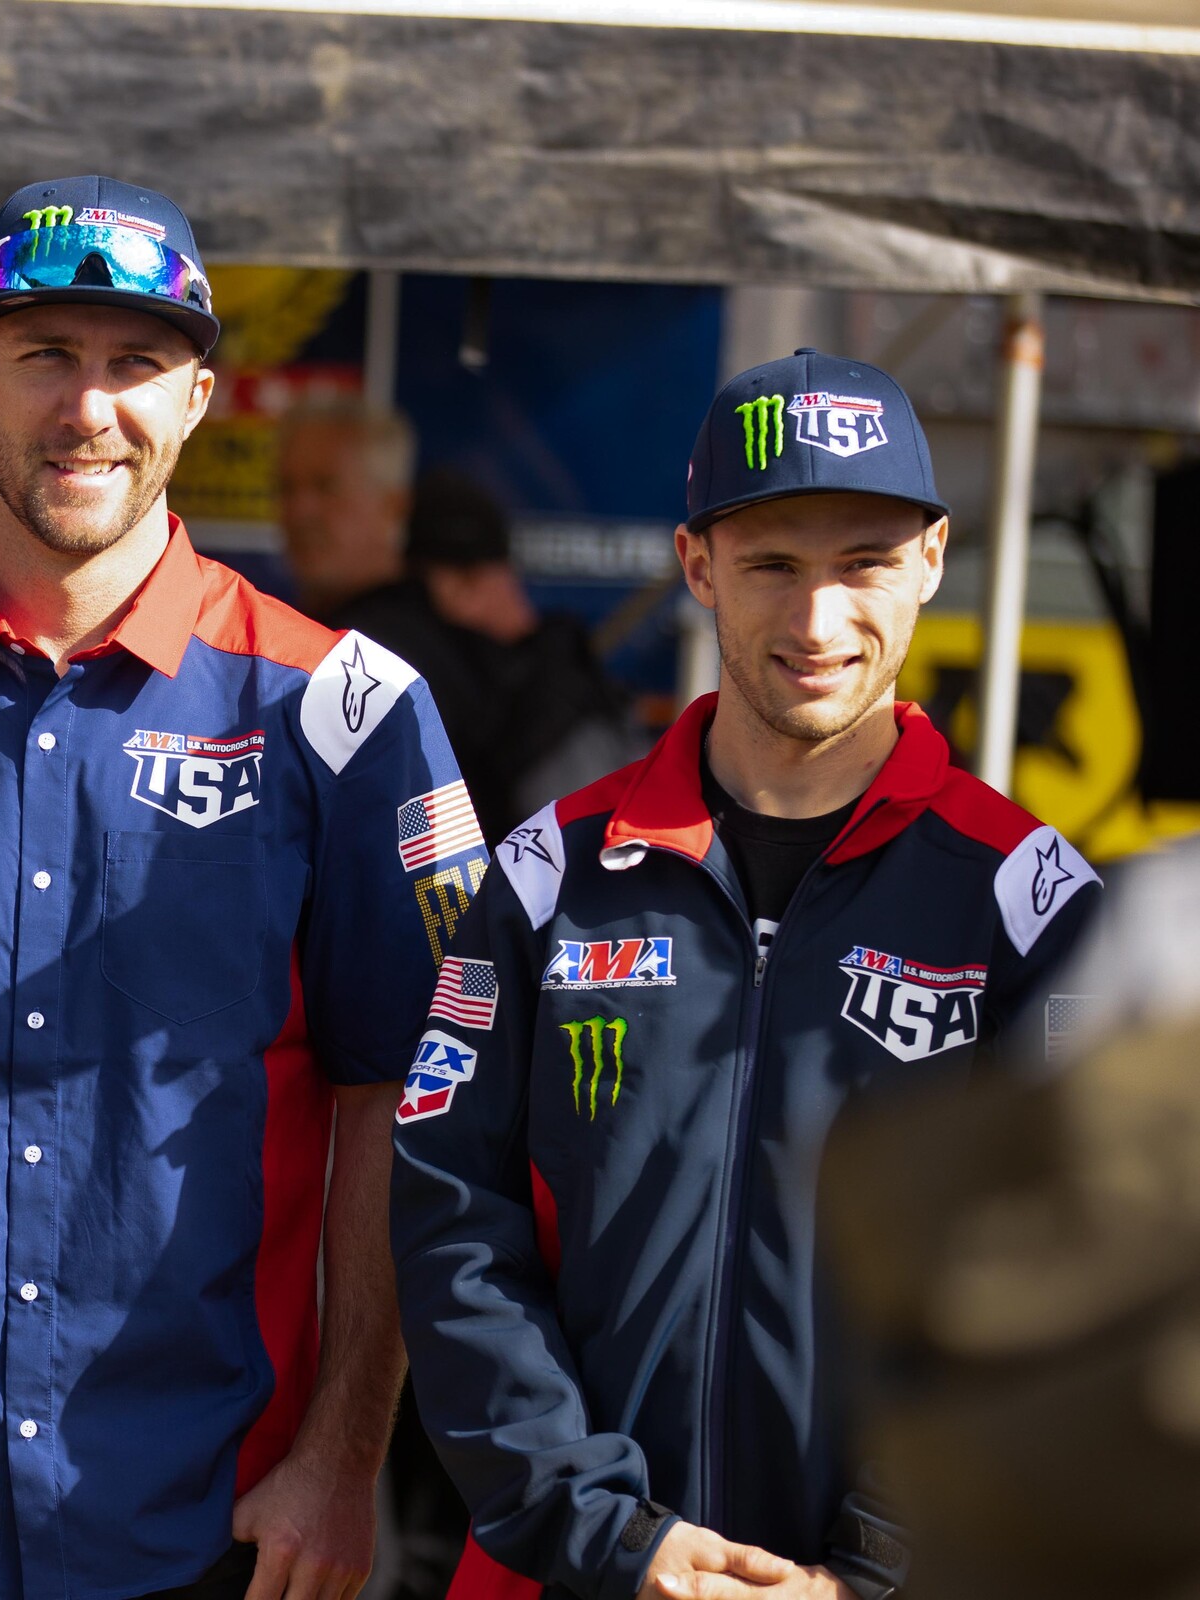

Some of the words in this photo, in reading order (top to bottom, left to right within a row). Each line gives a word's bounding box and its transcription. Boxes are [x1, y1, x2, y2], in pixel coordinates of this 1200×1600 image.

[75, 208, 118, 223] AMA
[787, 392, 831, 410] AMA
[798, 409, 886, 456] USA
[122, 729, 186, 753] AMA
[186, 740, 202, 750] U.S.
[203, 739, 249, 753] MOTOCROSS
[134, 755, 260, 822] USA
[541, 937, 677, 984] AMA
[838, 945, 903, 977] AMA
[902, 965, 918, 977] U.S.
[918, 969, 964, 983] MOTOCROSS
[965, 970, 987, 981] TEAM
[845, 971, 977, 1062] USA
